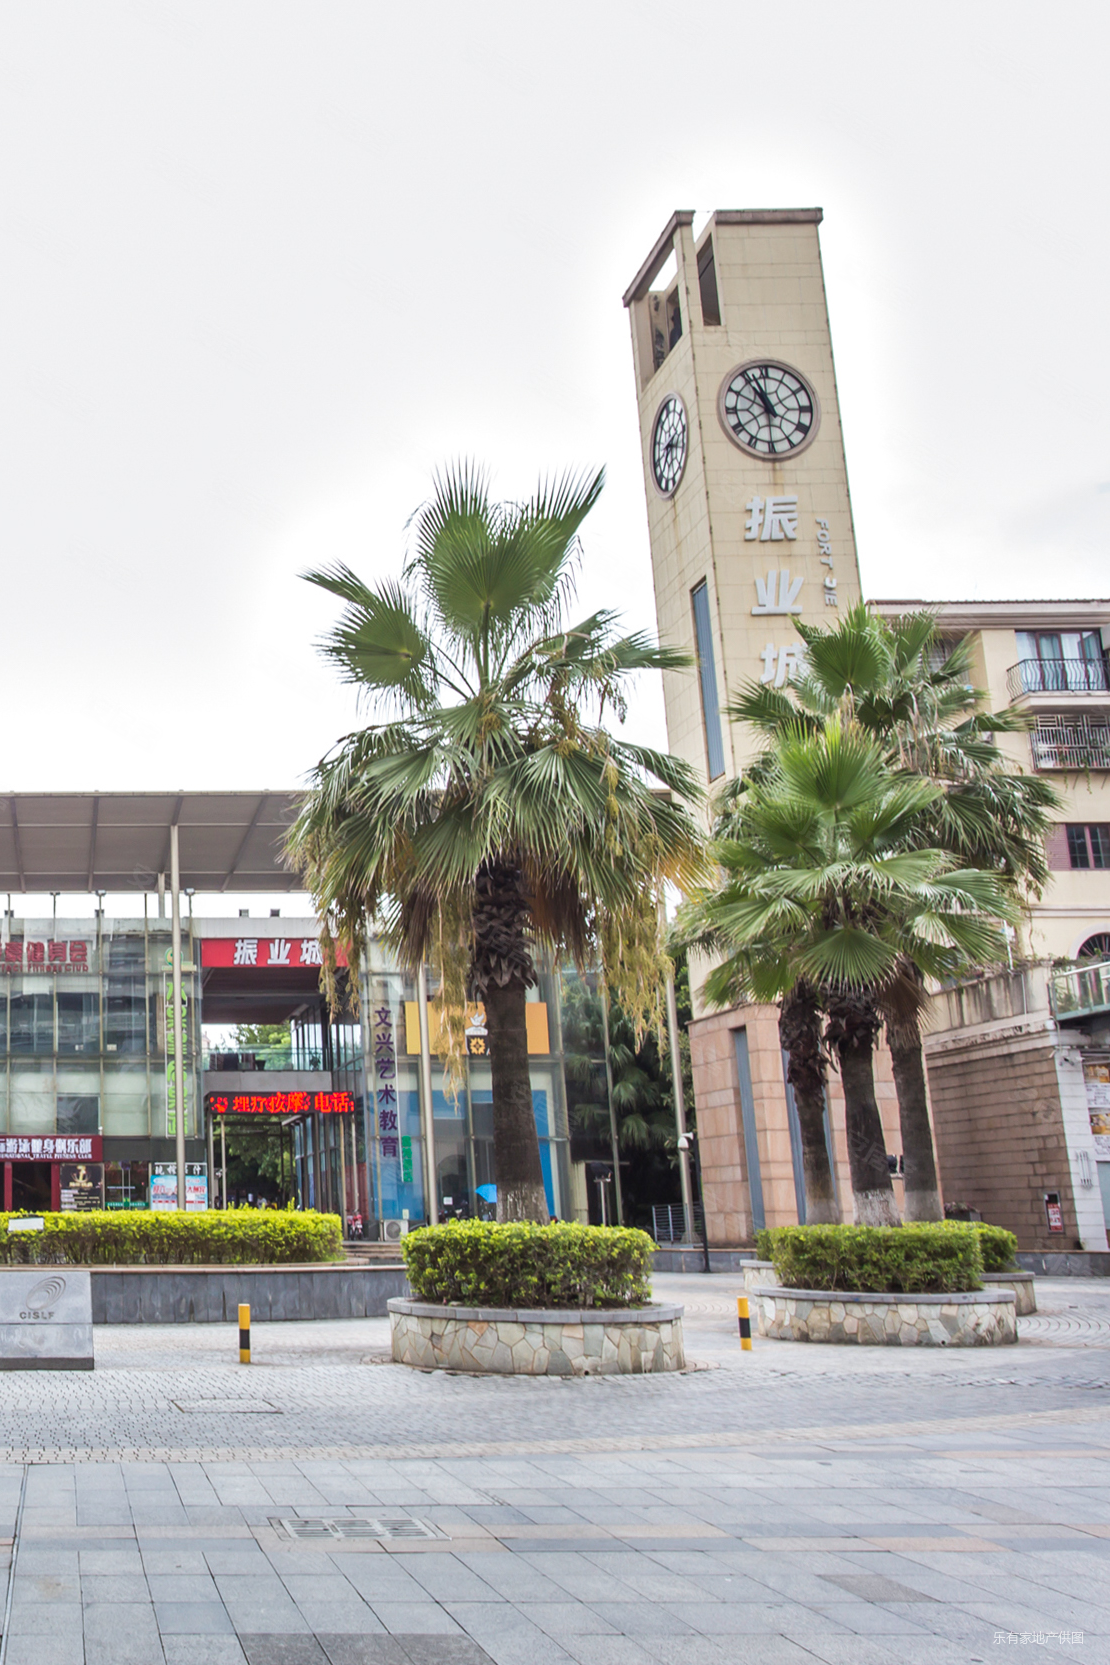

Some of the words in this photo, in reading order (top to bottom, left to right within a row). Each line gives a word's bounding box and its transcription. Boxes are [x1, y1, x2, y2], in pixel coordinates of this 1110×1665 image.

[233, 939, 323, 965] 振业城
[374, 1007, 399, 1157] 文兴艺术教育
[19, 1311, 55, 1320] CISLF
